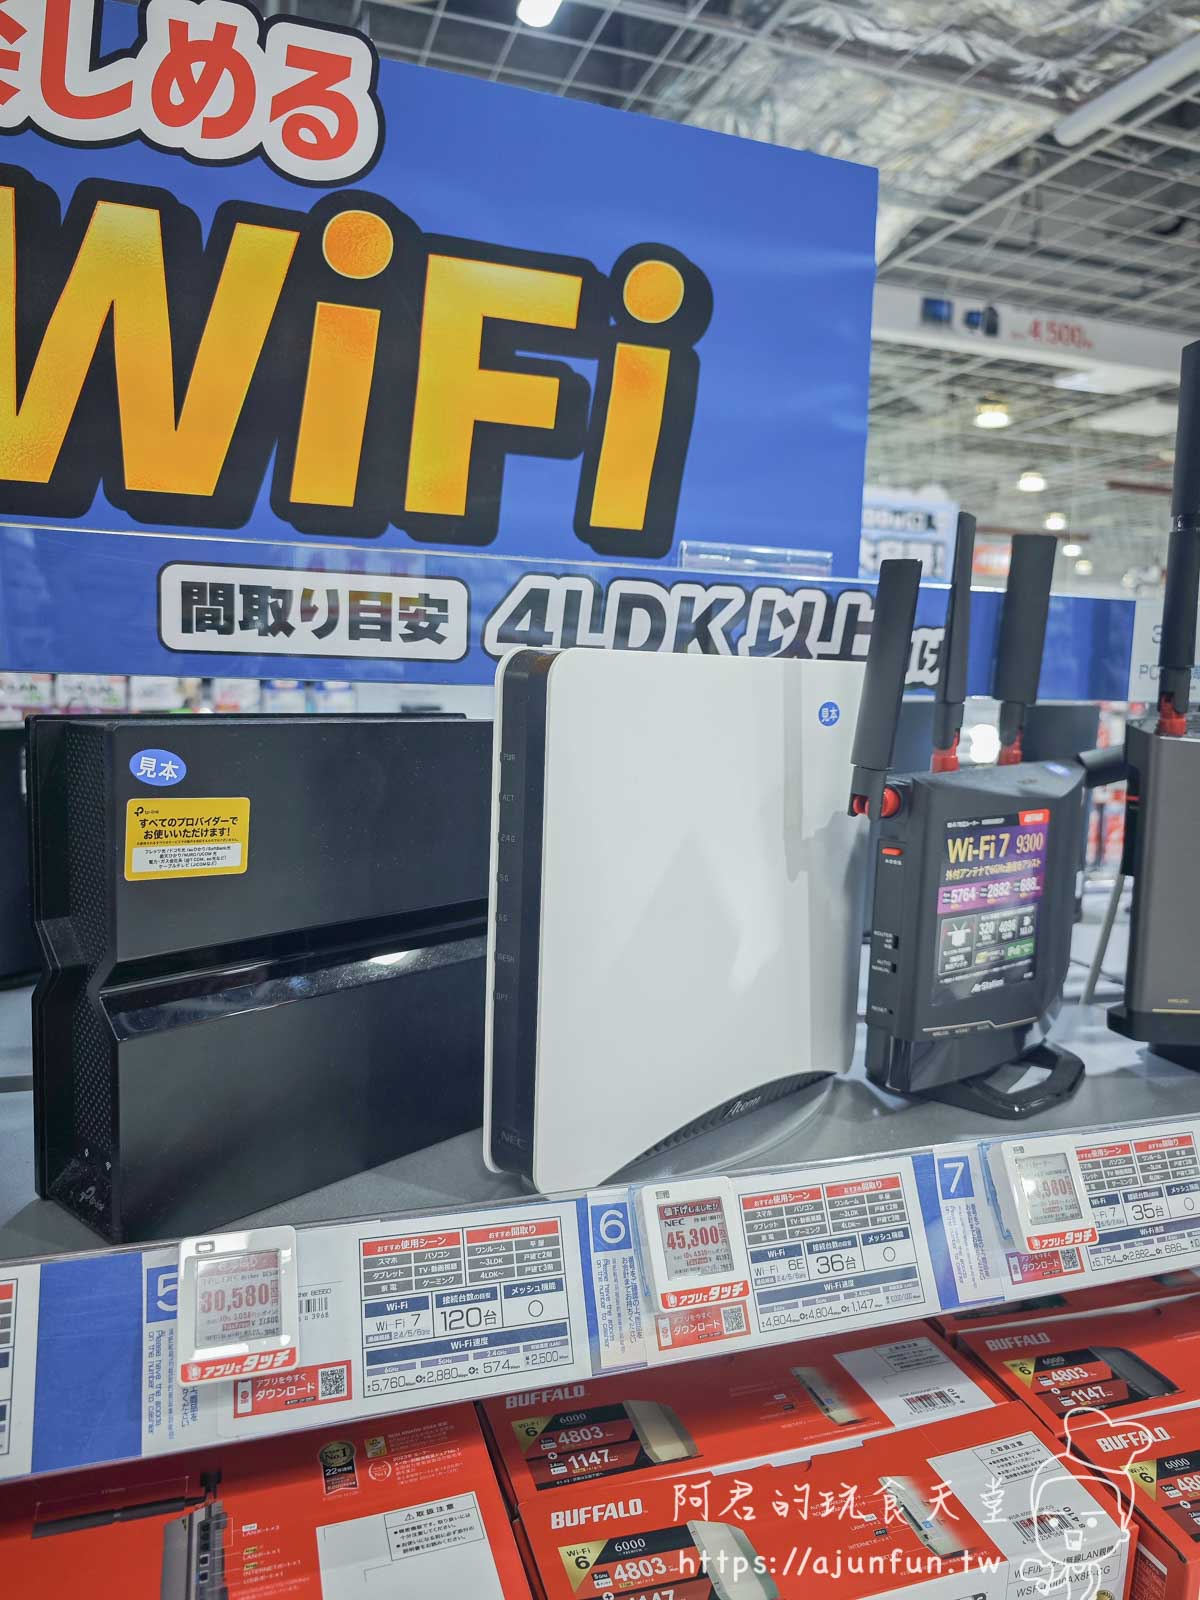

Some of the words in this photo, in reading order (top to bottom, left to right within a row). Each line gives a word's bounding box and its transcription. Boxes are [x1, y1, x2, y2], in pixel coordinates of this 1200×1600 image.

[0, 0, 360, 162] しめる
[180, 581, 454, 645] 間取り目安
[821, 706, 838, 721] 見本
[137, 757, 179, 780] 見本
[139, 816, 238, 828] すべてのプロバイダーで
[144, 828, 230, 840] お使いいただけます!
[948, 834, 996, 864] Wi-Fi
[999, 833, 1010, 858] 7
[1016, 832, 1043, 854] 9300
[951, 887, 976, 903] 5764
[944, 1162, 964, 1193] 7
[794, 1204, 814, 1212] パソコン
[834, 1198, 860, 1206] ワンルーム
[1132, 1203, 1164, 1220] 35台
[600, 1210, 626, 1244] 6
[664, 1218, 686, 1228] NEC
[753, 1222, 778, 1230] タブレット
[489, 1225, 536, 1238] おすすめ間取り
[667, 1226, 720, 1250] 45,300
[378, 1236, 446, 1252] おすすめ使用シーン
[476, 1244, 506, 1254] ワンルーム
[424, 1251, 450, 1260] パソコン
[768, 1248, 786, 1258] Wi-Fi
[378, 1258, 398, 1266] スマホ
[788, 1258, 806, 1271] 6E
[816, 1254, 856, 1274] 36台
[1022, 1260, 1060, 1272] ダウンロード
[372, 1270, 404, 1280] タブレット
[422, 1276, 454, 1287] ゲーミング
[512, 1282, 556, 1296] メッシュ機能
[201, 1283, 270, 1312] 30,580
[386, 1301, 408, 1312] Wi-Fi
[808, 1306, 833, 1320] 4,804
[376, 1318, 406, 1332] Wi-Fi
[411, 1314, 420, 1326] 7
[440, 1307, 496, 1332] 120台
[766, 1314, 792, 1328] 4,804
[674, 1320, 720, 1336] ダウンロード
[450, 1336, 488, 1350] Wi-Fi速度
[985, 1332, 1050, 1352] BUFFALO
[531, 1351, 558, 1366] 2,500
[484, 1360, 510, 1374] 574
[426, 1368, 458, 1383] 2,880
[1051, 1367, 1088, 1382] 4803
[256, 1382, 315, 1400] ダウンロード
[372, 1376, 406, 1392] 5,760
[506, 1384, 585, 1409] BUFFALO
[1071, 1386, 1106, 1402] 1147
[560, 1412, 586, 1424] 6000
[526, 1426, 538, 1437] 6
[558, 1426, 604, 1444] 4803
[1096, 1426, 1170, 1452] BUFFALO
[568, 1448, 610, 1469] 1147
[1165, 1458, 1190, 1470] 6000
[1140, 1472, 1154, 1484] 6
[416, 1504, 454, 1516] 取扱注意
[551, 1498, 642, 1530] BUFFALO
[614, 1538, 646, 1552] 6000
[566, 1548, 590, 1558] Wi-Fi
[575, 1556, 590, 1570] 6
[614, 1558, 666, 1582] 4803
